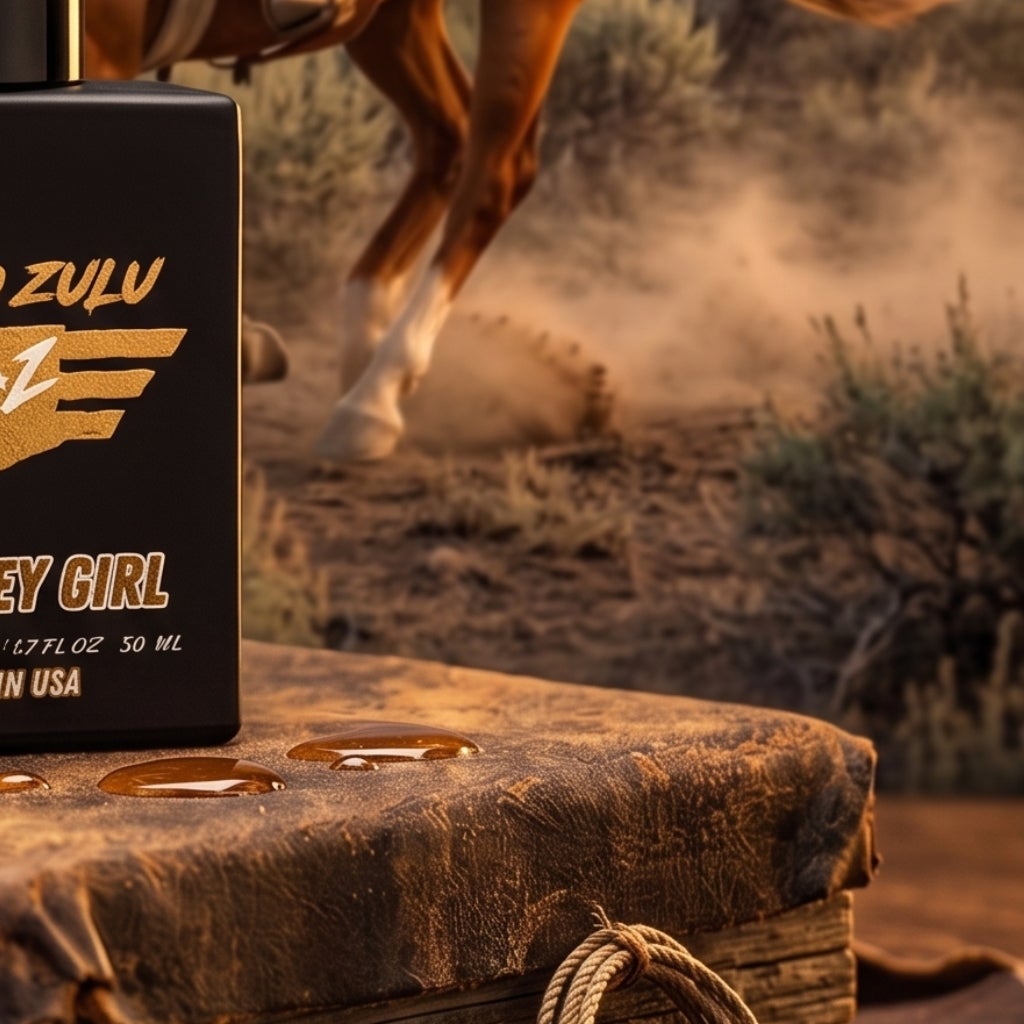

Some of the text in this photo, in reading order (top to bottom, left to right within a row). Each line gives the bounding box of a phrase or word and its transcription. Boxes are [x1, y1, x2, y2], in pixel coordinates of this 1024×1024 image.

[7, 256, 166, 316] ZULU
[57, 551, 170, 612] GIRL
[41, 638, 65, 655] FL
[70, 636, 105, 654] OZ
[119, 635, 146, 653] 50
[29, 666, 82, 699] USA
